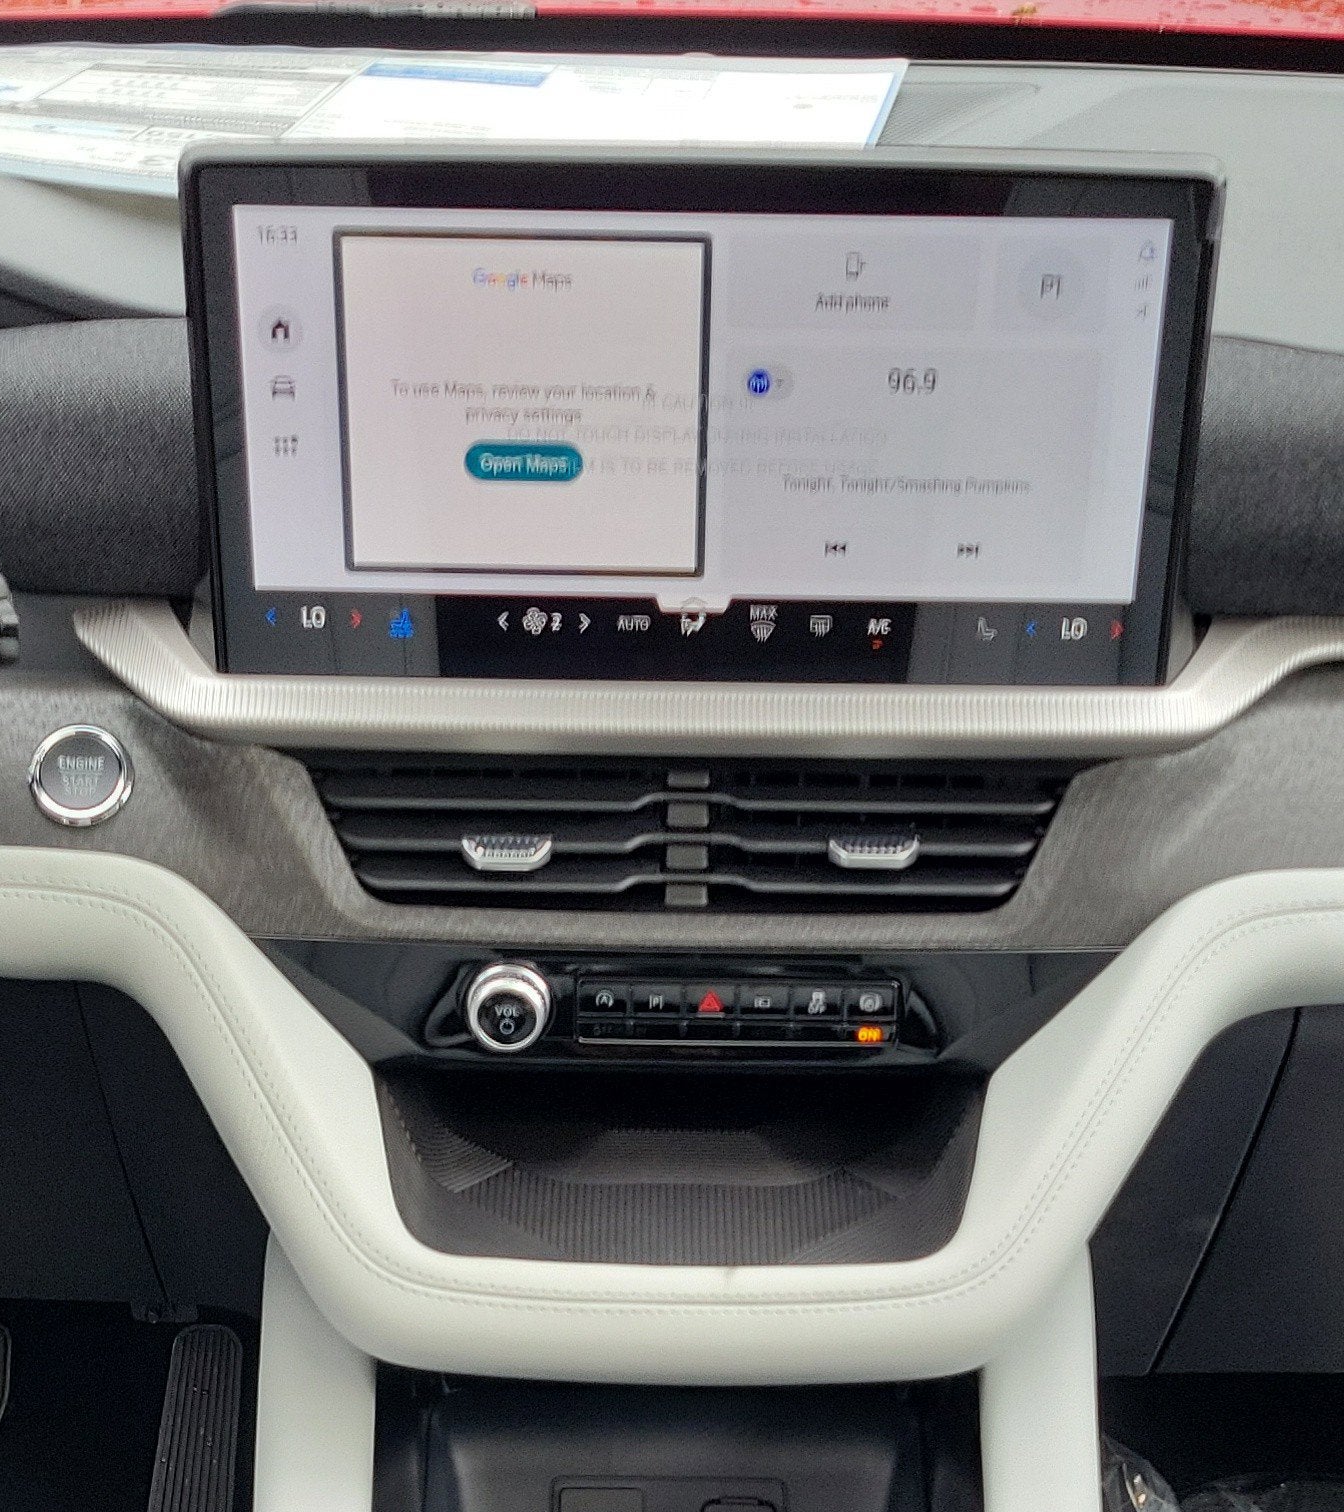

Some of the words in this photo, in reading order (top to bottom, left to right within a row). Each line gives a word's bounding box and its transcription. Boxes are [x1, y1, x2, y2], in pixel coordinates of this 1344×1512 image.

[472, 267, 529, 291] Google
[531, 268, 573, 290] Maps
[815, 292, 843, 311] Add
[845, 292, 890, 313] phone
[391, 378, 410, 398] To
[413, 382, 440, 399] use
[492, 382, 540, 400] review
[543, 383, 576, 403] your
[581, 381, 641, 401] location
[887, 367, 938, 396] 96.9
[464, 405, 520, 426] privacy
[523, 405, 582, 427] settings
[480, 452, 522, 476] Open
[524, 452, 570, 476] Maps
[965, 477, 1032, 497] Pumpkins
[299, 604, 327, 630] LO
[551, 611, 563, 632] 2
[749, 604, 779, 621] MAX
[617, 613, 651, 633] AUTO
[867, 617, 892, 636] A/C
[1060, 616, 1088, 641] LO
[57, 754, 105, 771] ENGINE
[61, 773, 99, 787] START
[64, 786, 97, 797] STOP
[494, 1005, 520, 1018] VOL
[857, 1026, 882, 1042] ON
